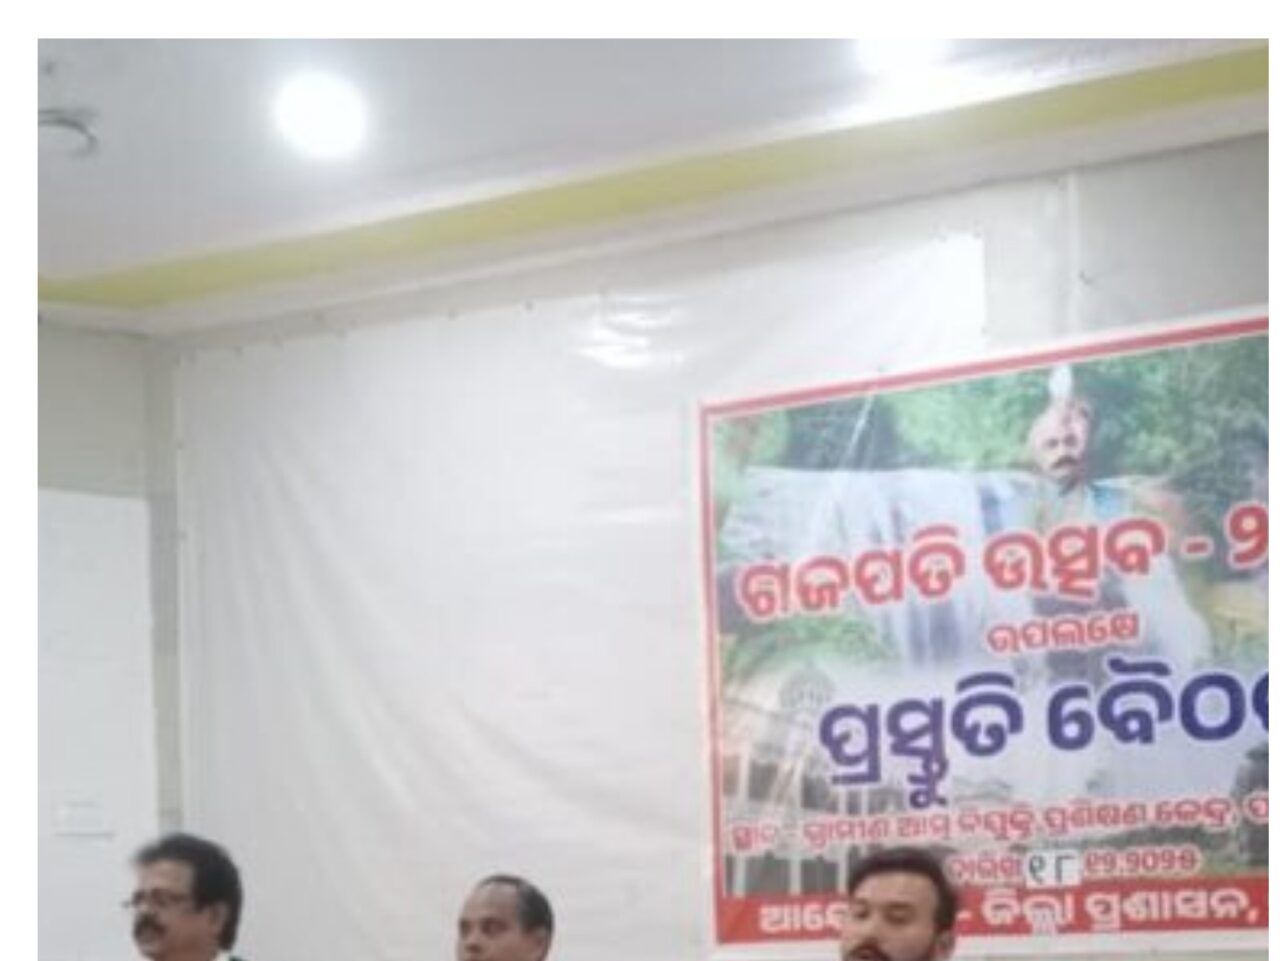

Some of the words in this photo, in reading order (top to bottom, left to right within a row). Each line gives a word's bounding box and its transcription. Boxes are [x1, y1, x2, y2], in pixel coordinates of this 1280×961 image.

[740, 523, 965, 618] ଗଜପତି
[983, 517, 1167, 598] ଉତ୍ସବ
[818, 671, 1025, 808] ପ୍ରସ୍ତୁତି
[1046, 657, 1269, 752] ବୈଠ
